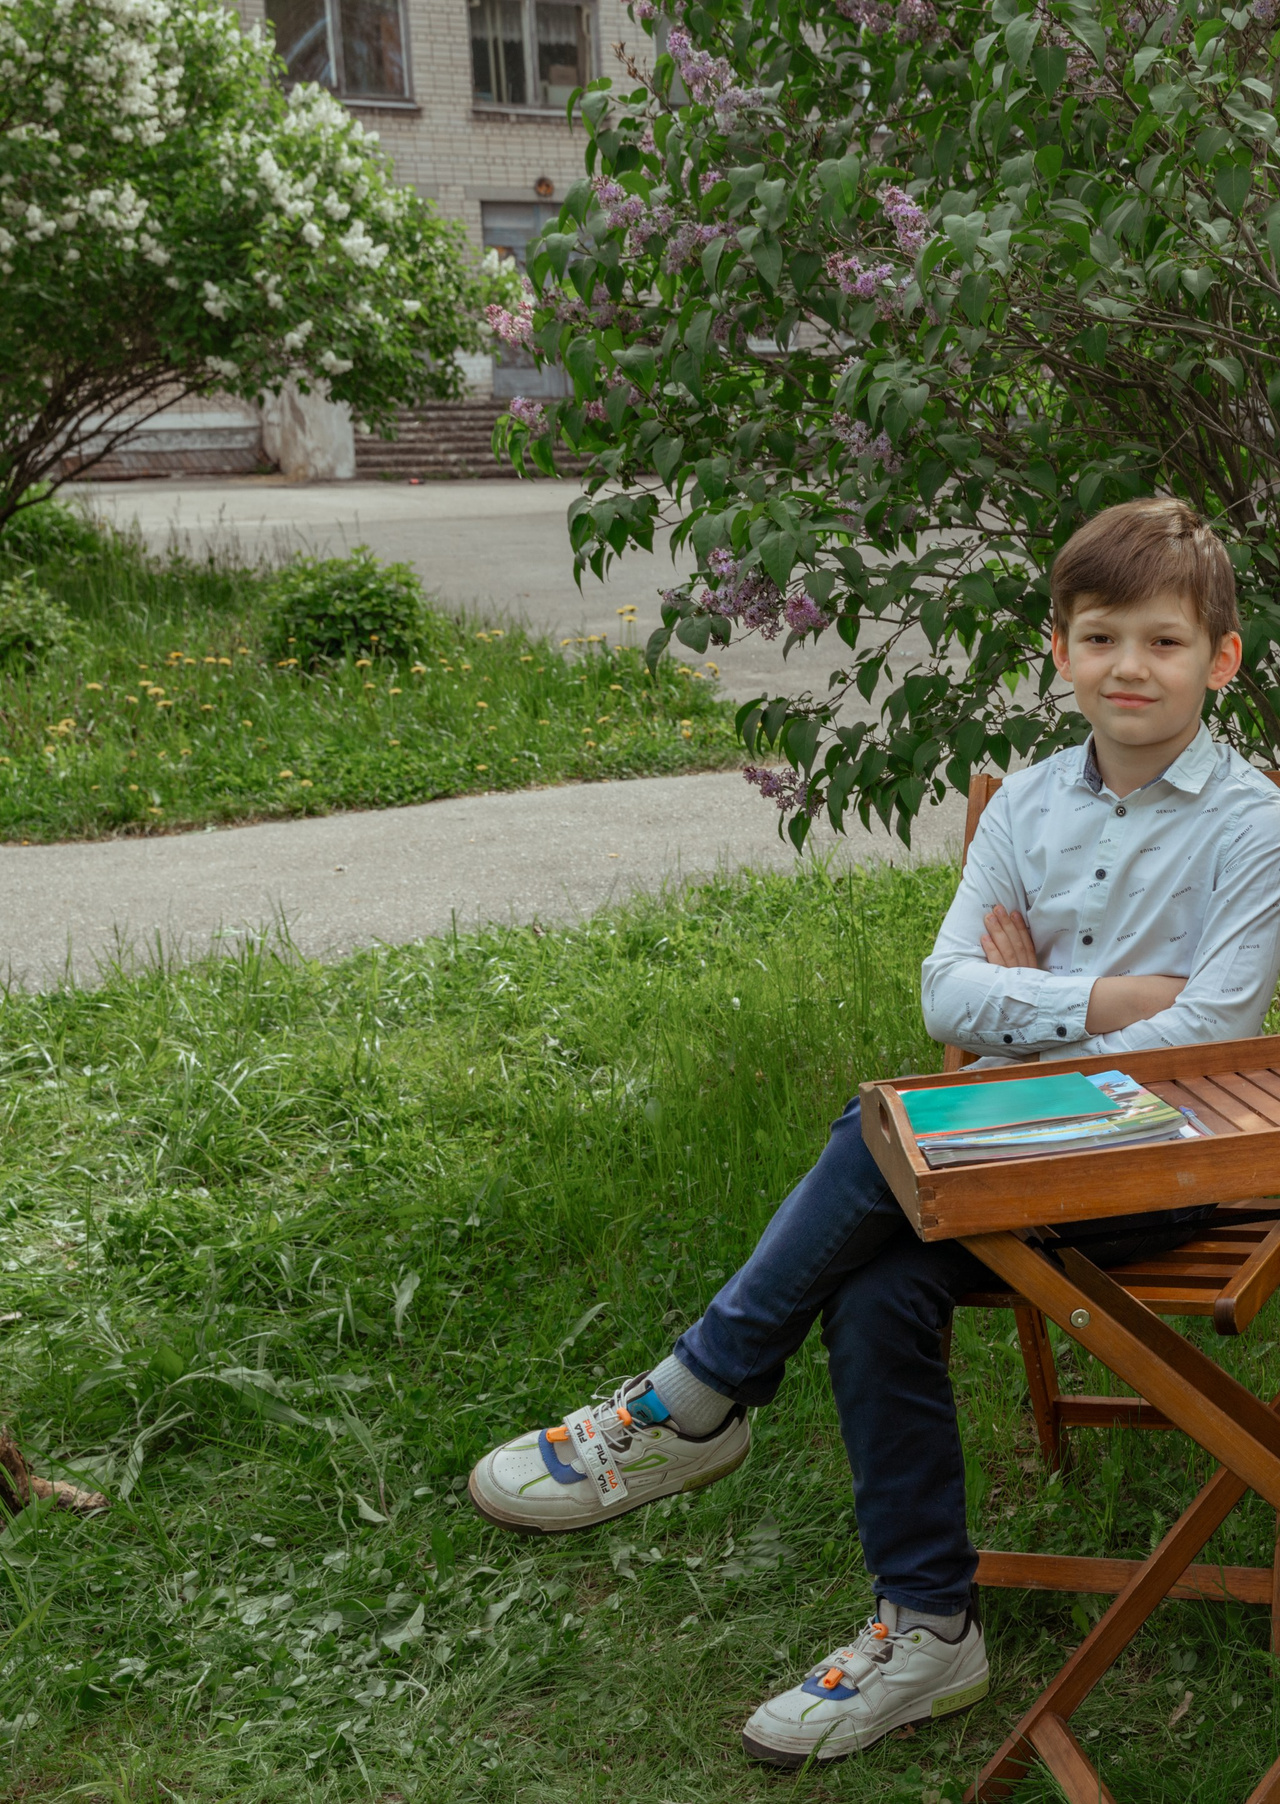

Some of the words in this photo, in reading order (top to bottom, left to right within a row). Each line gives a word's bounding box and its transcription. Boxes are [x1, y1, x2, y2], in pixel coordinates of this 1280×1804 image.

[1074, 801, 1095, 812] GENIUS
[1155, 807, 1177, 815] GENIUS
[1234, 823, 1254, 844] GENIUS
[1060, 844, 1082, 855] GENIUS
[1139, 845, 1161, 855] GENIUS
[1050, 889, 1071, 900] GENIUS
[1171, 885, 1192, 899] GENIUS
[1221, 986, 1244, 994] GENIUS
[1196, 1014, 1218, 1025] GENIUS
[574, 1423, 587, 1443] FILA
[583, 1419, 595, 1439] FILA
[594, 1444, 608, 1465] FILA
[598, 1474, 610, 1494] FILA
[605, 1469, 618, 1489] FILA
